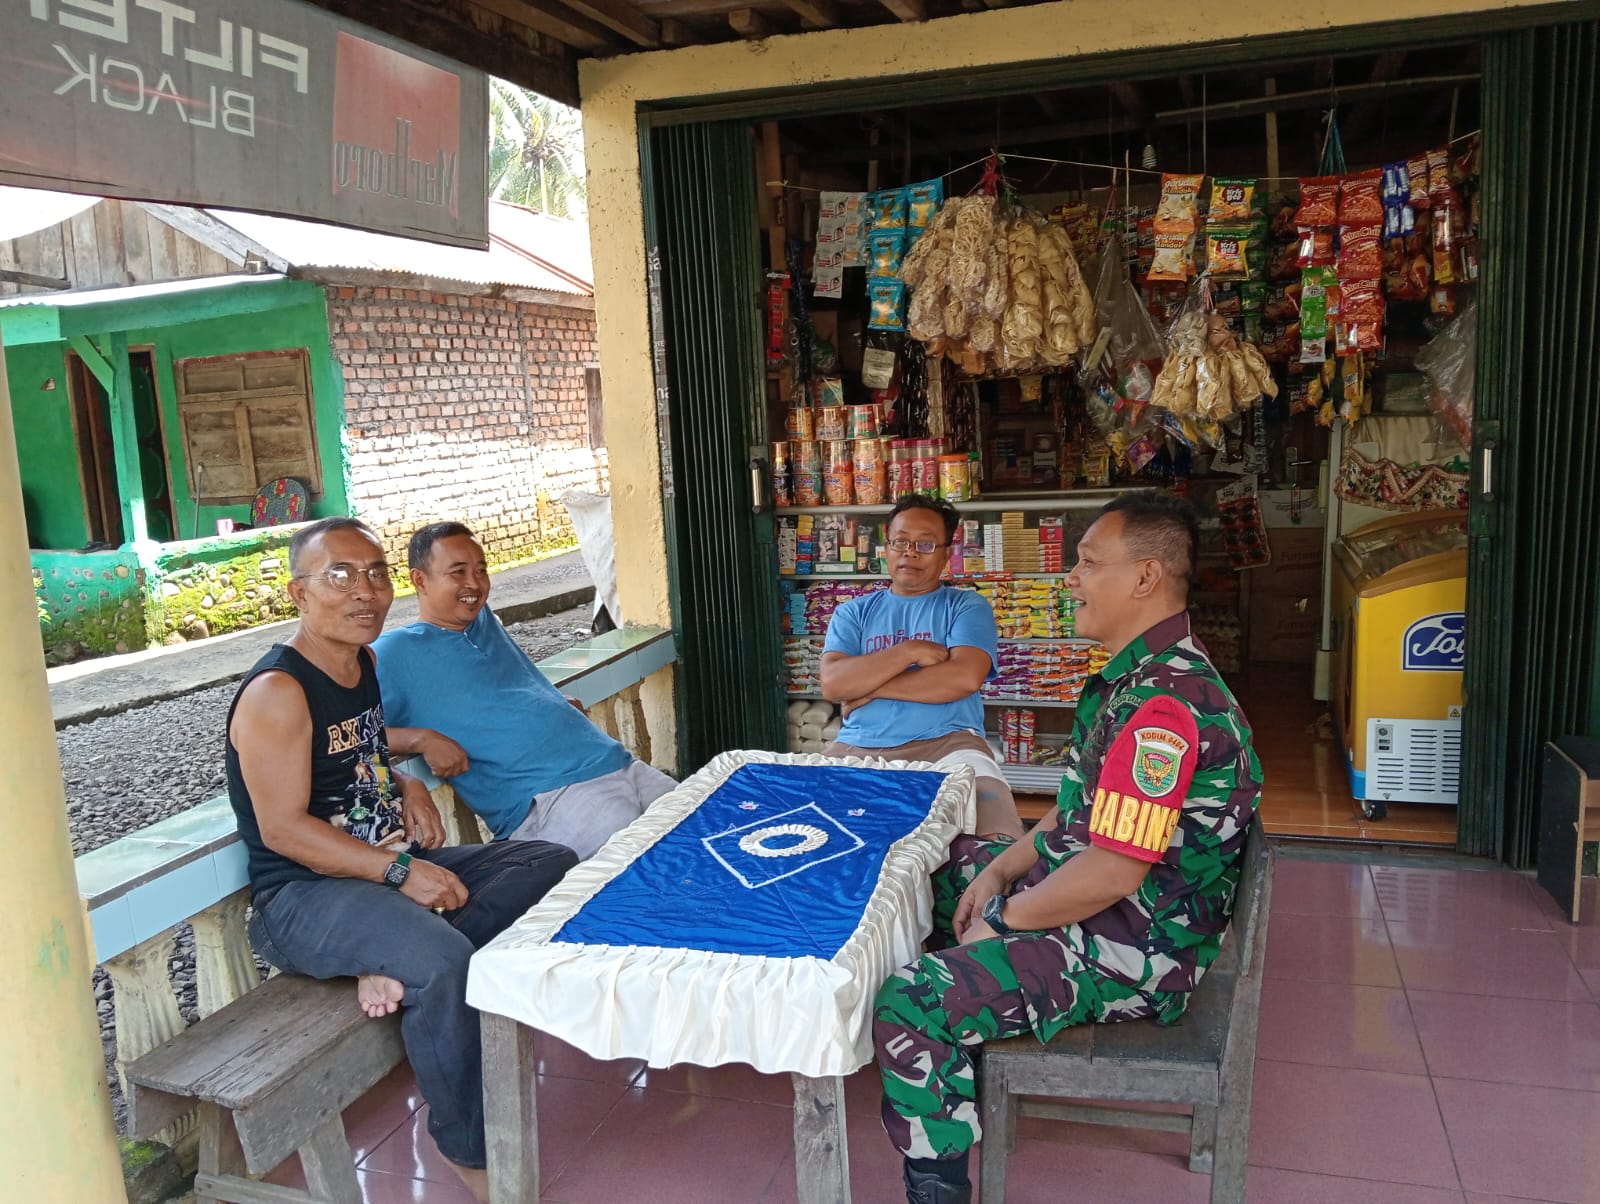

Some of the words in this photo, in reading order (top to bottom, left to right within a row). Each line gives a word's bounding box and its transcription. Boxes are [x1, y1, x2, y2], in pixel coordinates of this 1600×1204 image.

[865, 631, 932, 656] CONV
[1140, 731, 1167, 742] KODIM
[1167, 736, 1186, 751] 0404
